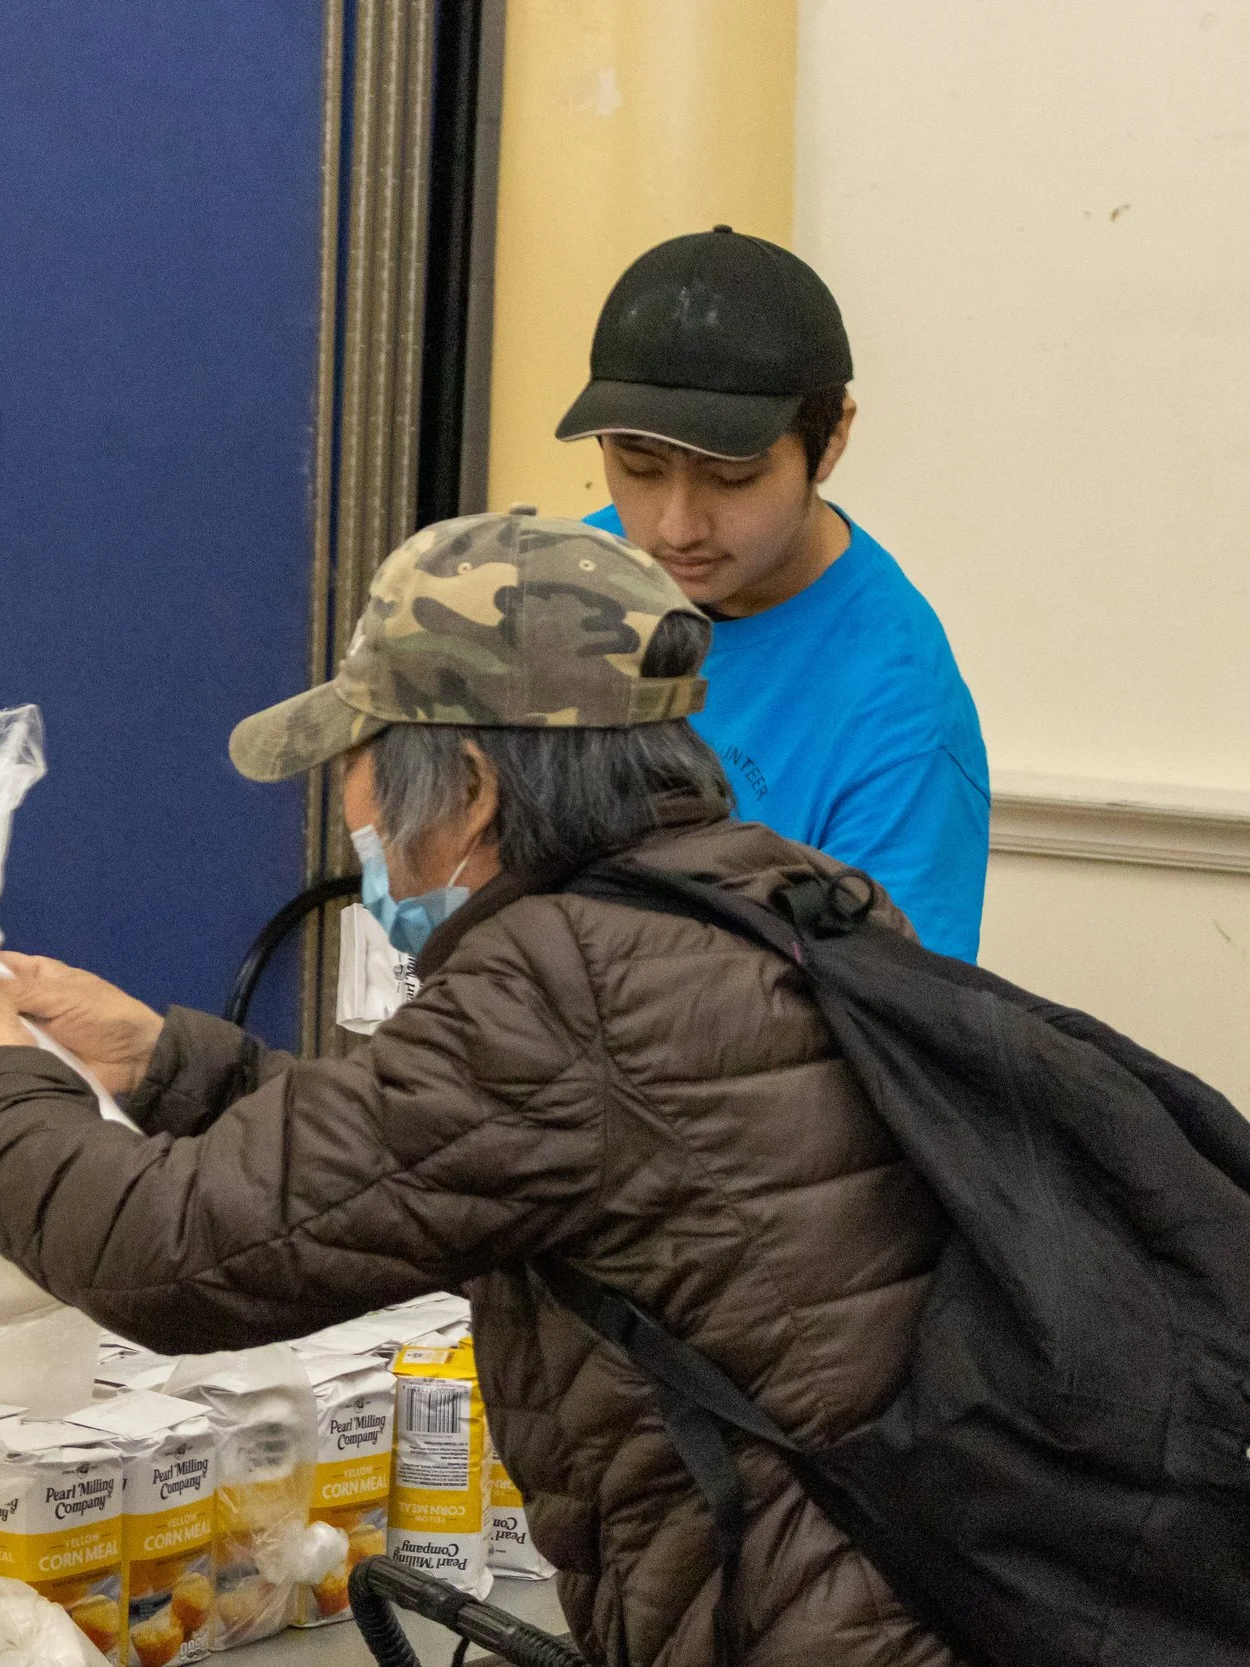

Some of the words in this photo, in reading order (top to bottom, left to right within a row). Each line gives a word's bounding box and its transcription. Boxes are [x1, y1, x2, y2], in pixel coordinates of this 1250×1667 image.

[330, 1418, 353, 1434] Pearl
[354, 1414, 386, 1430] Milling
[337, 1430, 378, 1450] Company
[153, 1465, 174, 1484] Pearl
[174, 1459, 208, 1477] Milling
[343, 1465, 373, 1479] YELLOW
[45, 1485, 76, 1503] Pearl
[78, 1478, 114, 1496] Milling
[159, 1475, 201, 1500] Company
[322, 1479, 359, 1499] CORN
[360, 1475, 389, 1494] MEAL
[55, 1495, 106, 1519] Company
[399, 1501, 429, 1514] MEAL
[429, 1505, 466, 1516] CORN
[167, 1512, 198, 1527] YELLOW
[64, 1533, 99, 1547] YELLOW
[143, 1531, 182, 1551] CORN
[184, 1519, 211, 1540] MEAL
[496, 1530, 526, 1544] Pearl
[38, 1553, 83, 1572] CORN
[85, 1541, 119, 1563] MEAL
[402, 1540, 459, 1557] Company
[393, 1549, 434, 1569] Milling
[436, 1557, 468, 1571] Pearl
